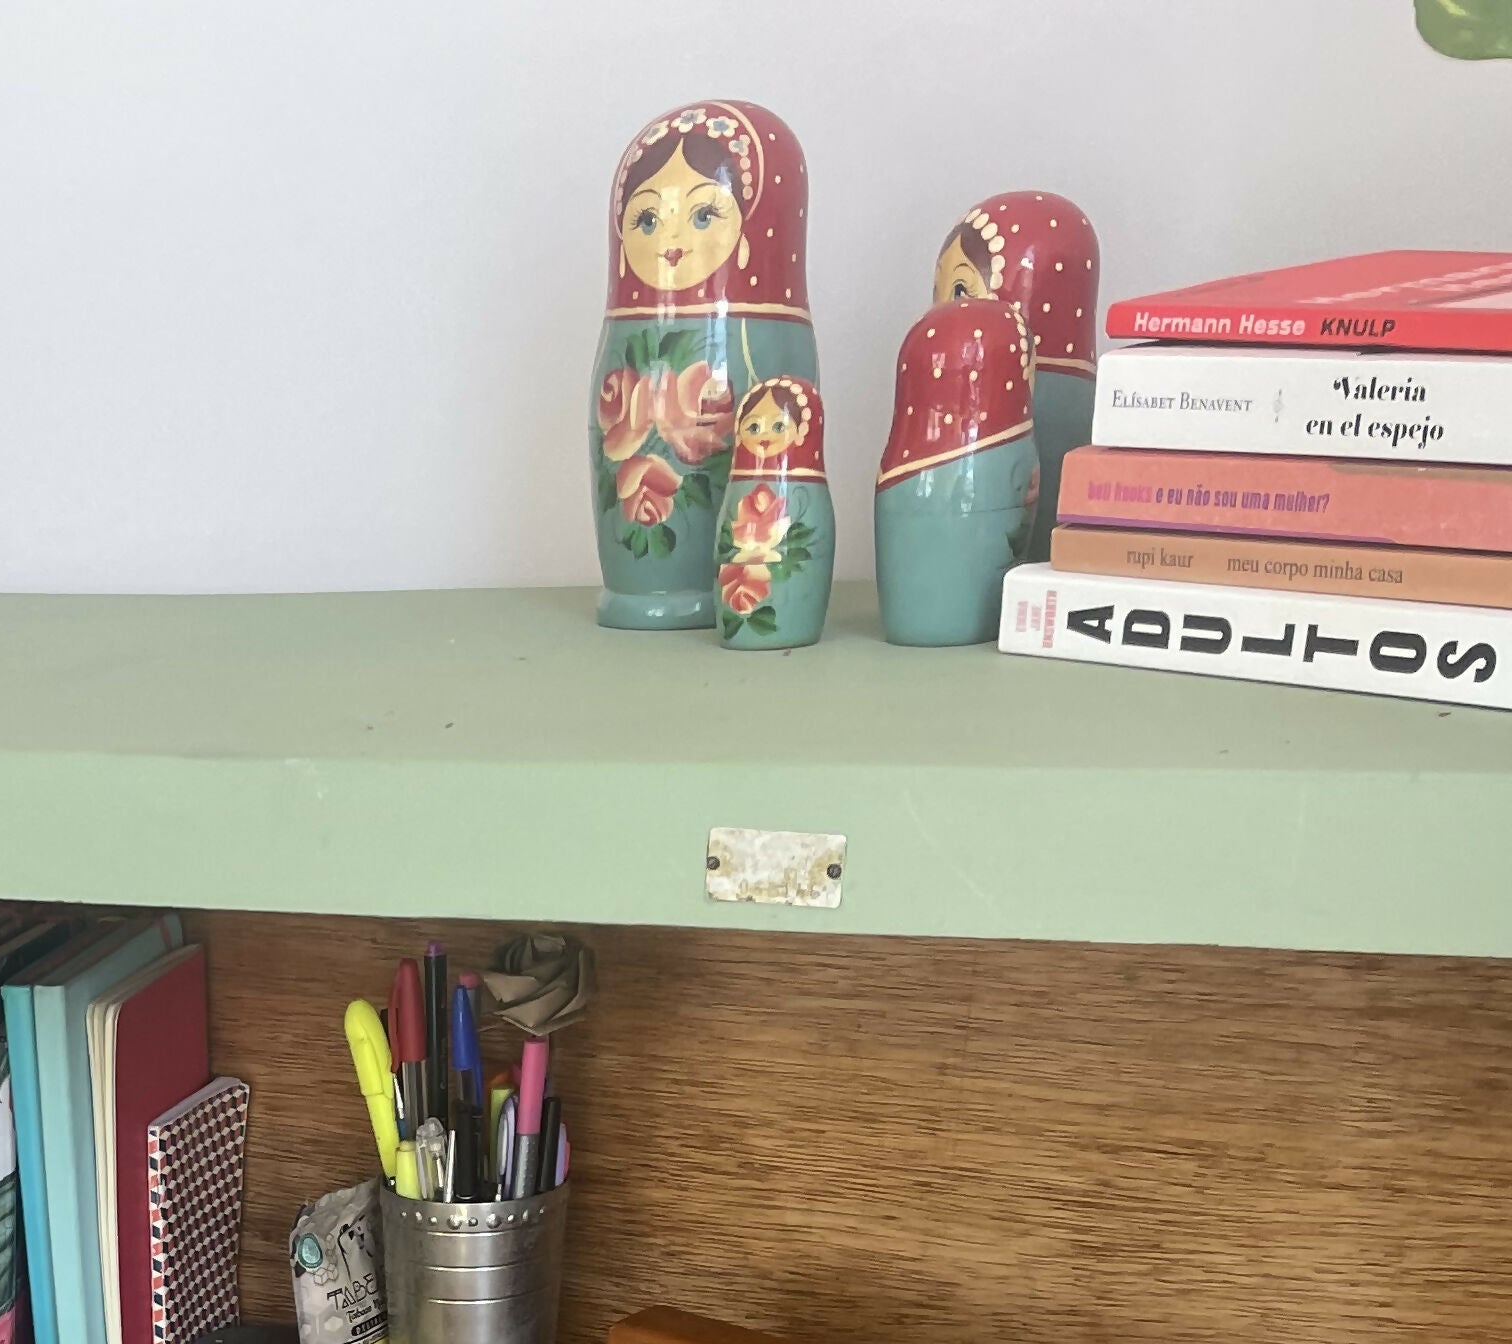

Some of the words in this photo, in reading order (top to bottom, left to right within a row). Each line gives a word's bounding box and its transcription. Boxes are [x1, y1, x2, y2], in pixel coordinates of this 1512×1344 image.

[1134, 312, 1230, 334] Hermann
[1238, 313, 1306, 337] Hesse
[1320, 317, 1396, 339] KNULP
[1306, 416, 1333, 438] en
[1340, 417, 1363, 439] el
[1367, 420, 1445, 450] espejo
[1167, 488, 1183, 505] eu
[1186, 484, 1211, 506] não
[1214, 489, 1237, 508] sou
[1241, 491, 1270, 510] uma
[1273, 490, 1331, 513] mulher?
[1126, 547, 1156, 570] rupi
[1160, 548, 1194, 570] kaur
[1227, 555, 1260, 575] meu
[1264, 557, 1309, 582] corpo
[1313, 560, 1364, 583] minha
[1368, 566, 1405, 585] casa
[1065, 603, 1499, 684] ADULTOS
